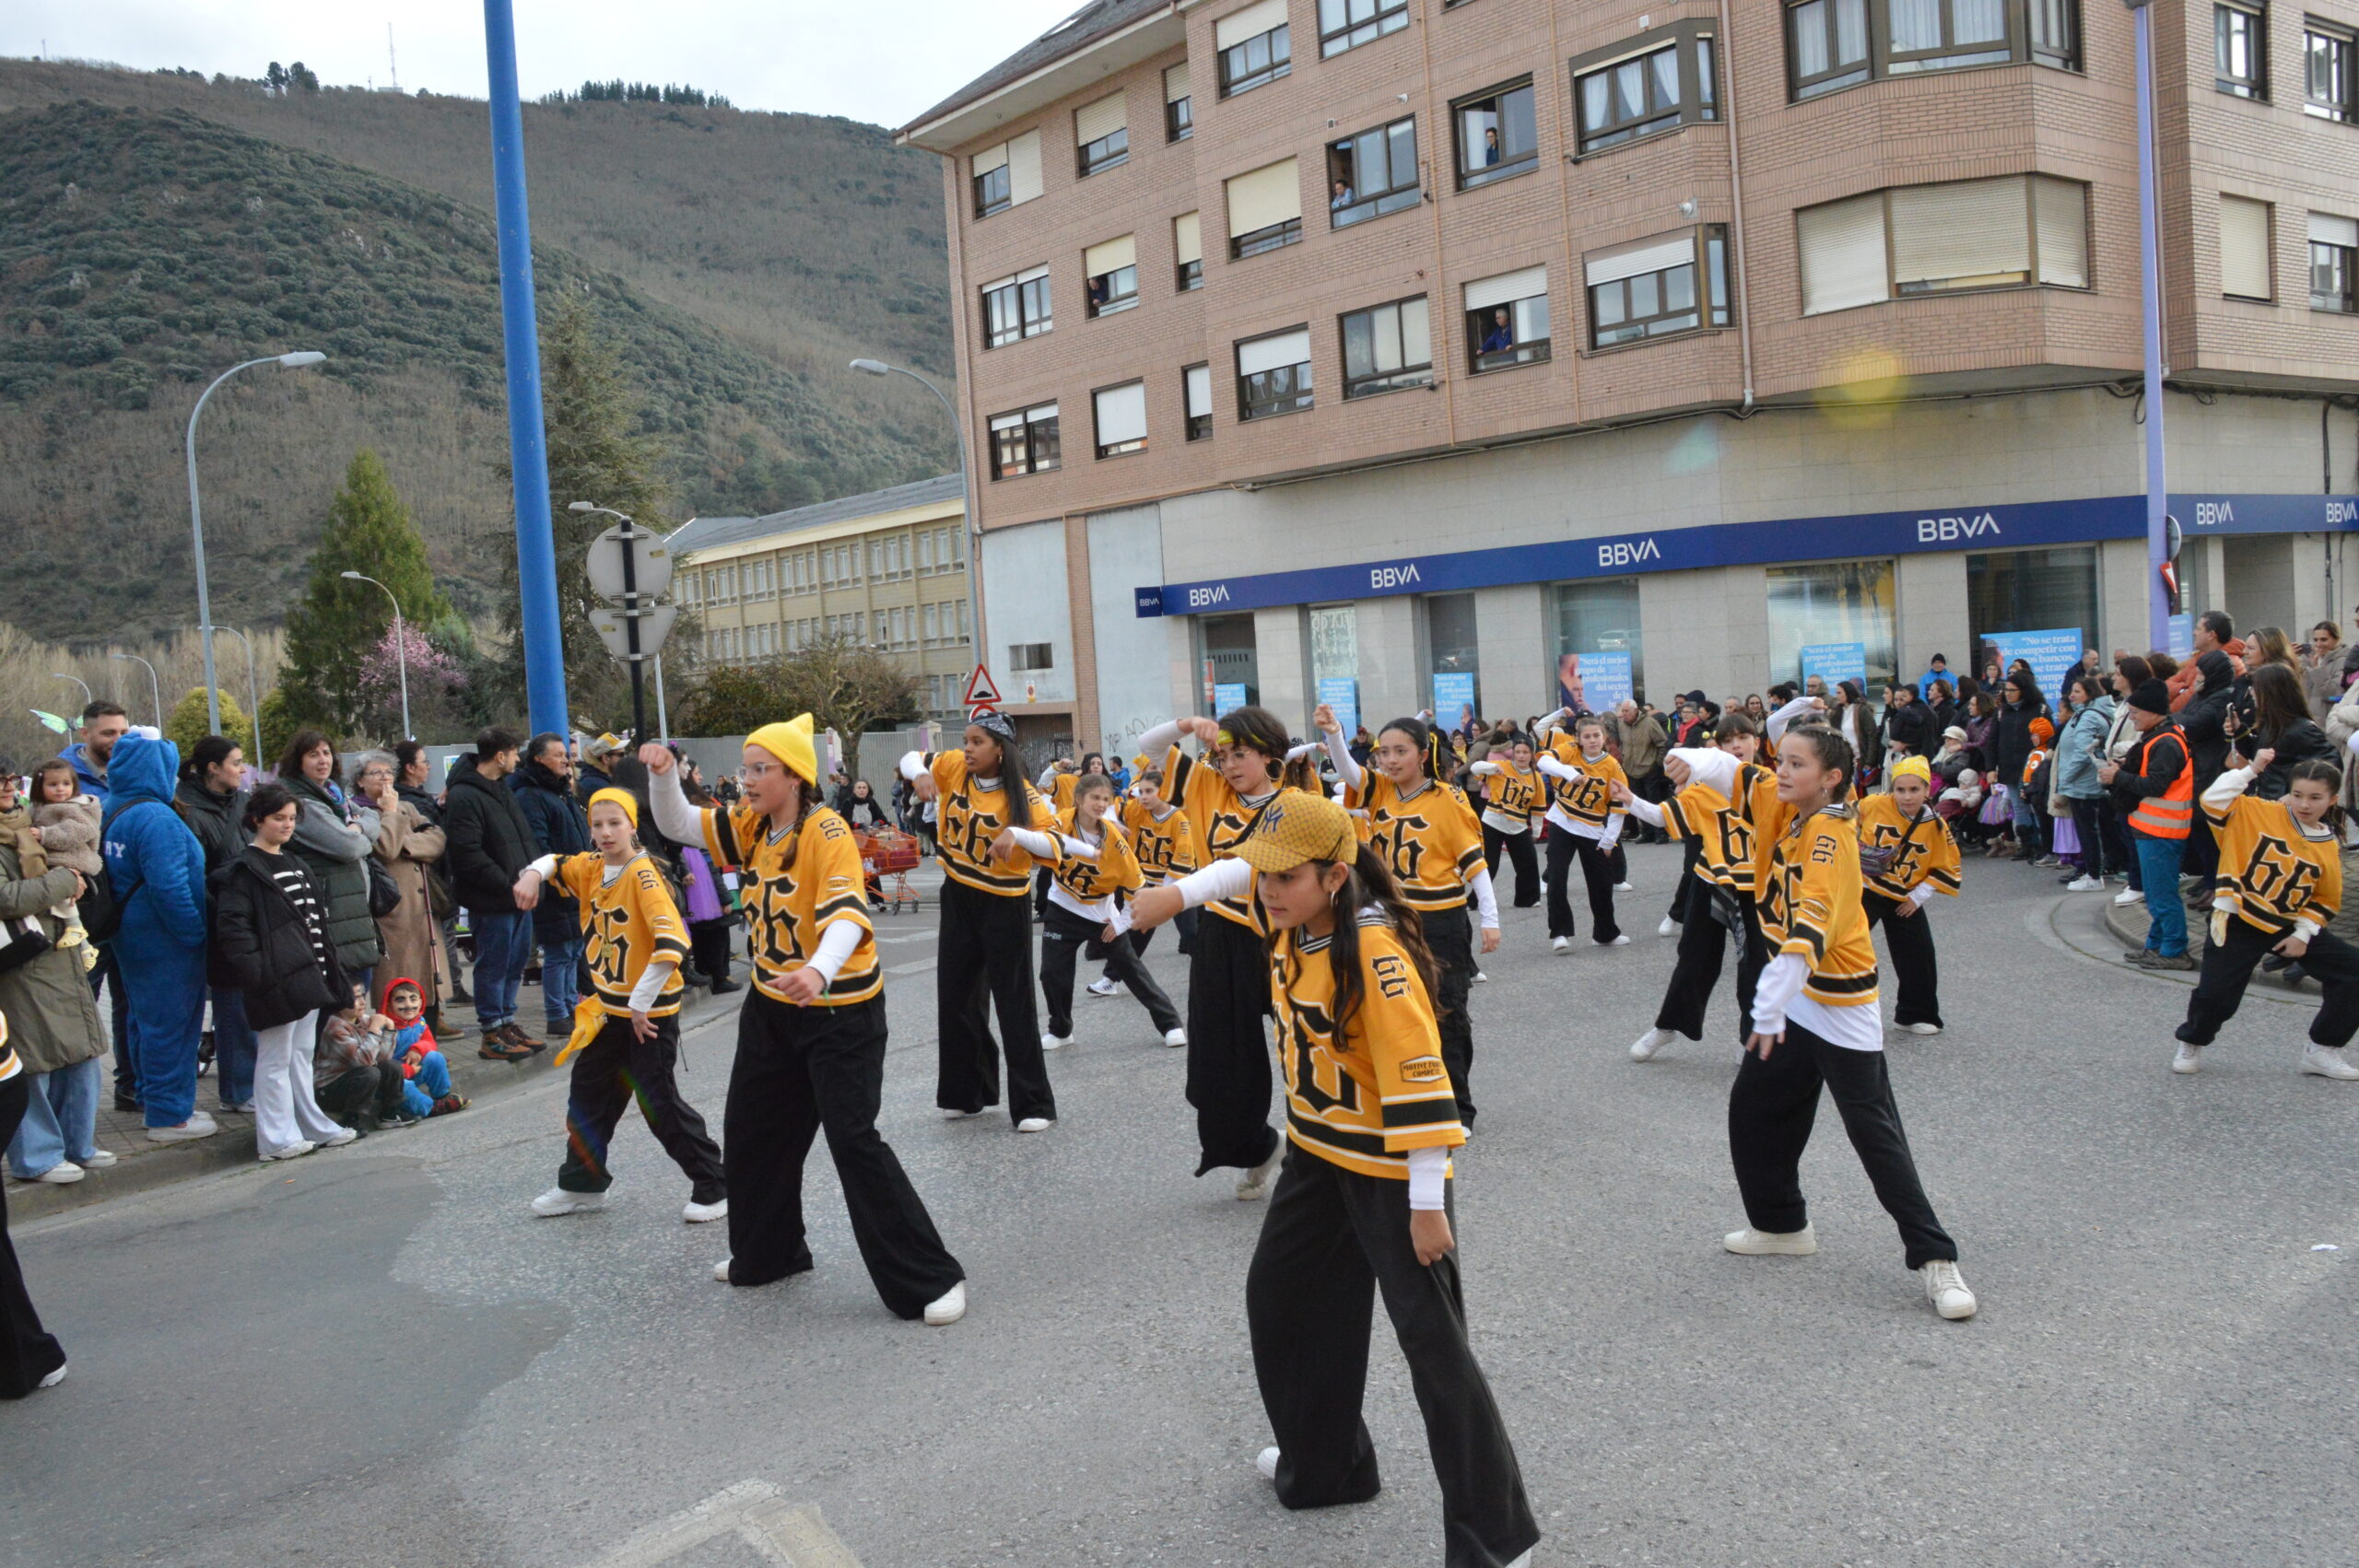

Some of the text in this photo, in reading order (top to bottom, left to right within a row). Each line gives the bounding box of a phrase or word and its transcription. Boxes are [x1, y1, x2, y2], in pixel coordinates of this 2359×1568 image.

[2197, 501, 2234, 525] BBVA
[2326, 501, 2358, 523] BBVA
[1918, 512, 2001, 542] BBVA
[1598, 538, 1661, 567] BBVA
[1371, 563, 1421, 589] BBVA
[1140, 598, 1159, 606] BBVA
[1190, 584, 1230, 606] BBVA
[2014, 646, 2057, 656] competir
[2059, 645, 2077, 653] con
[2052, 636, 2076, 644] trata
[1607, 655, 1628, 665] mejor
[2046, 663, 2069, 672] trata
[1501, 776, 1533, 809] 66
[819, 817, 847, 840] 66
[1135, 825, 1174, 868] 66
[1813, 835, 1837, 865] 66
[2240, 833, 2321, 914] 66
[1372, 954, 1412, 999] 66
